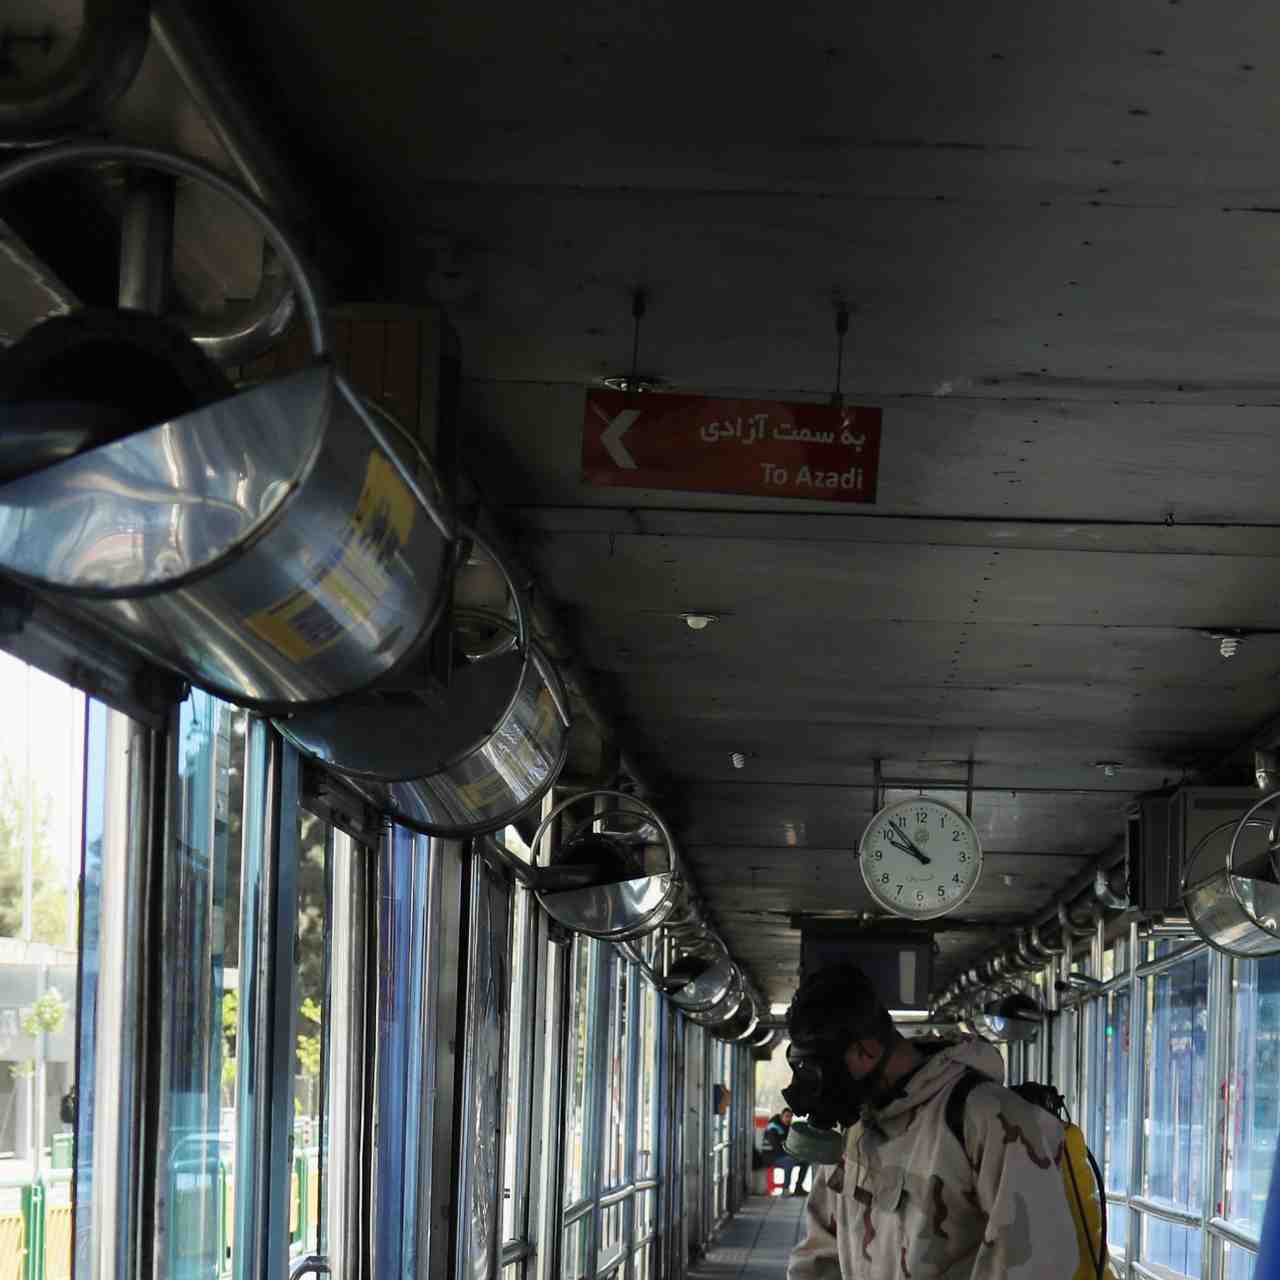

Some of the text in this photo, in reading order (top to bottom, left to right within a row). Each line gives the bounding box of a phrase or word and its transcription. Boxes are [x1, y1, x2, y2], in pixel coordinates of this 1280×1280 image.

[699, 413, 770, 447] آزادی
[772, 421, 833, 445] سمت
[760, 463, 864, 489] To Azadi
[898, 816, 907, 829] 11
[916, 812, 928, 825] 12
[880, 829, 894, 841] 10
[951, 831, 961, 842] 2
[874, 850, 883, 862] 9
[959, 851, 968, 863] 3
[881, 872, 890, 884] 8
[951, 872, 960, 884] 4
[896, 885, 904, 897] 7
[916, 891, 924, 902] 6
[937, 885, 945, 897] 5
